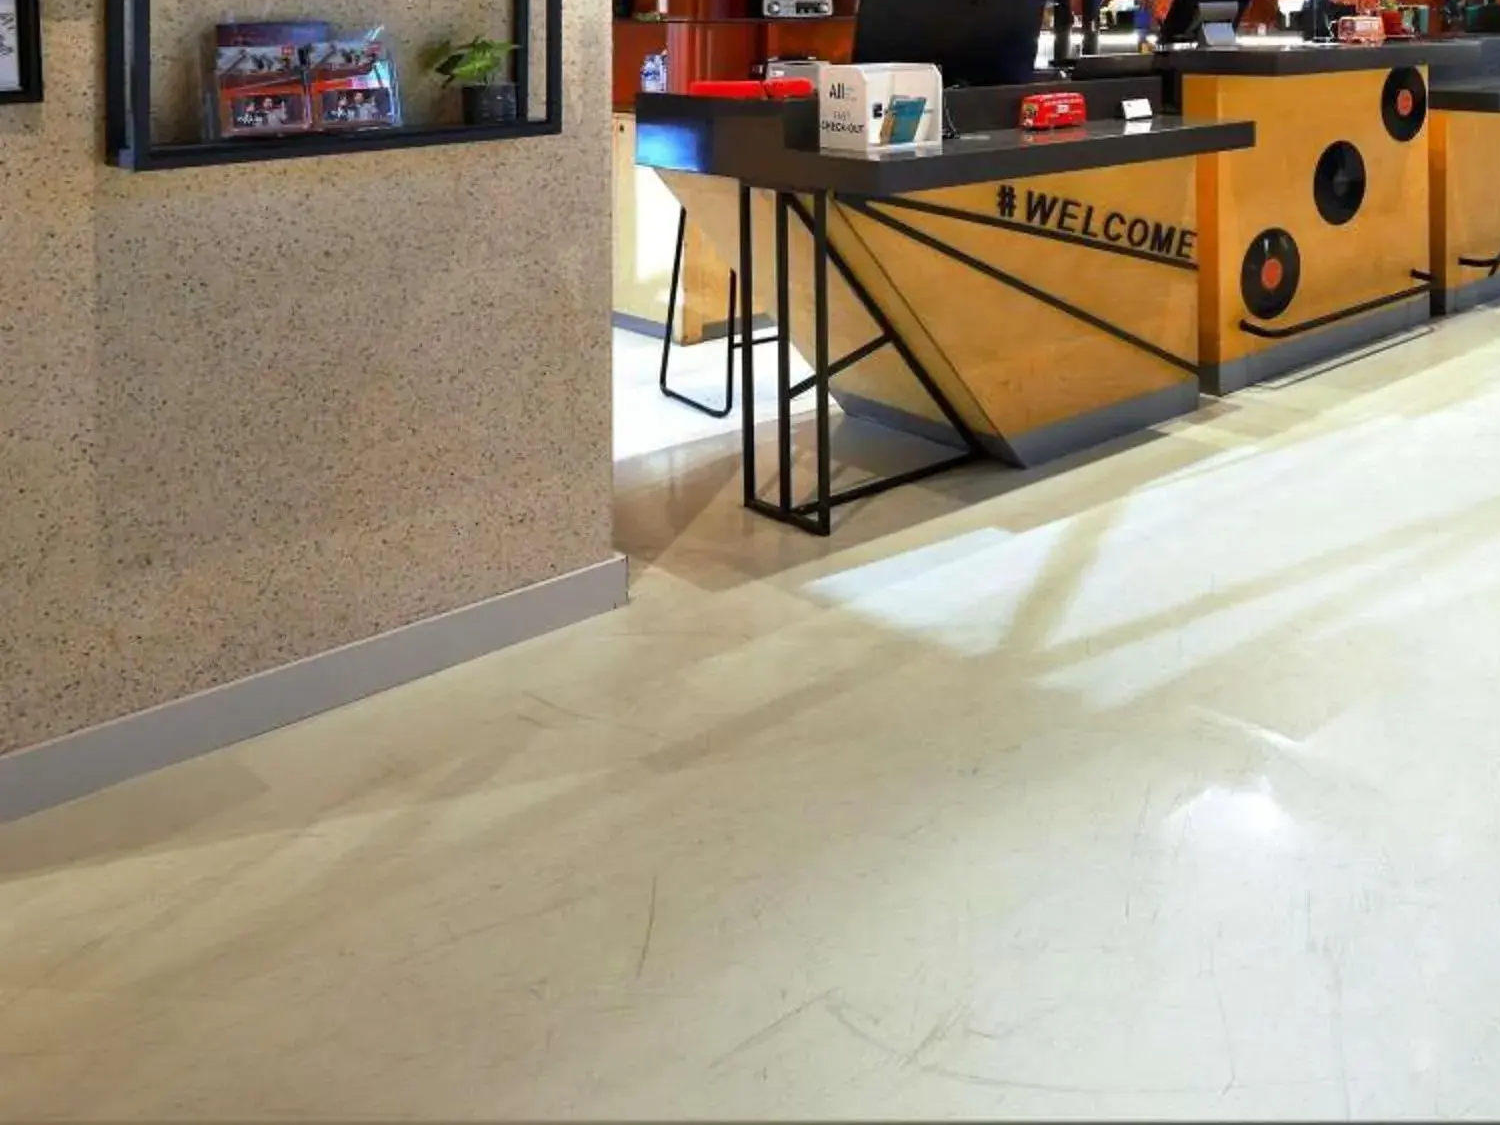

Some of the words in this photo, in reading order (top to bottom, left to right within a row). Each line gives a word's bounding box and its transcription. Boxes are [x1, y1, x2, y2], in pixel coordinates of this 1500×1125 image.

[829, 82, 845, 100] All
[821, 120, 864, 133] CHECK-OUT
[997, 184, 1199, 259] #WELCOME
